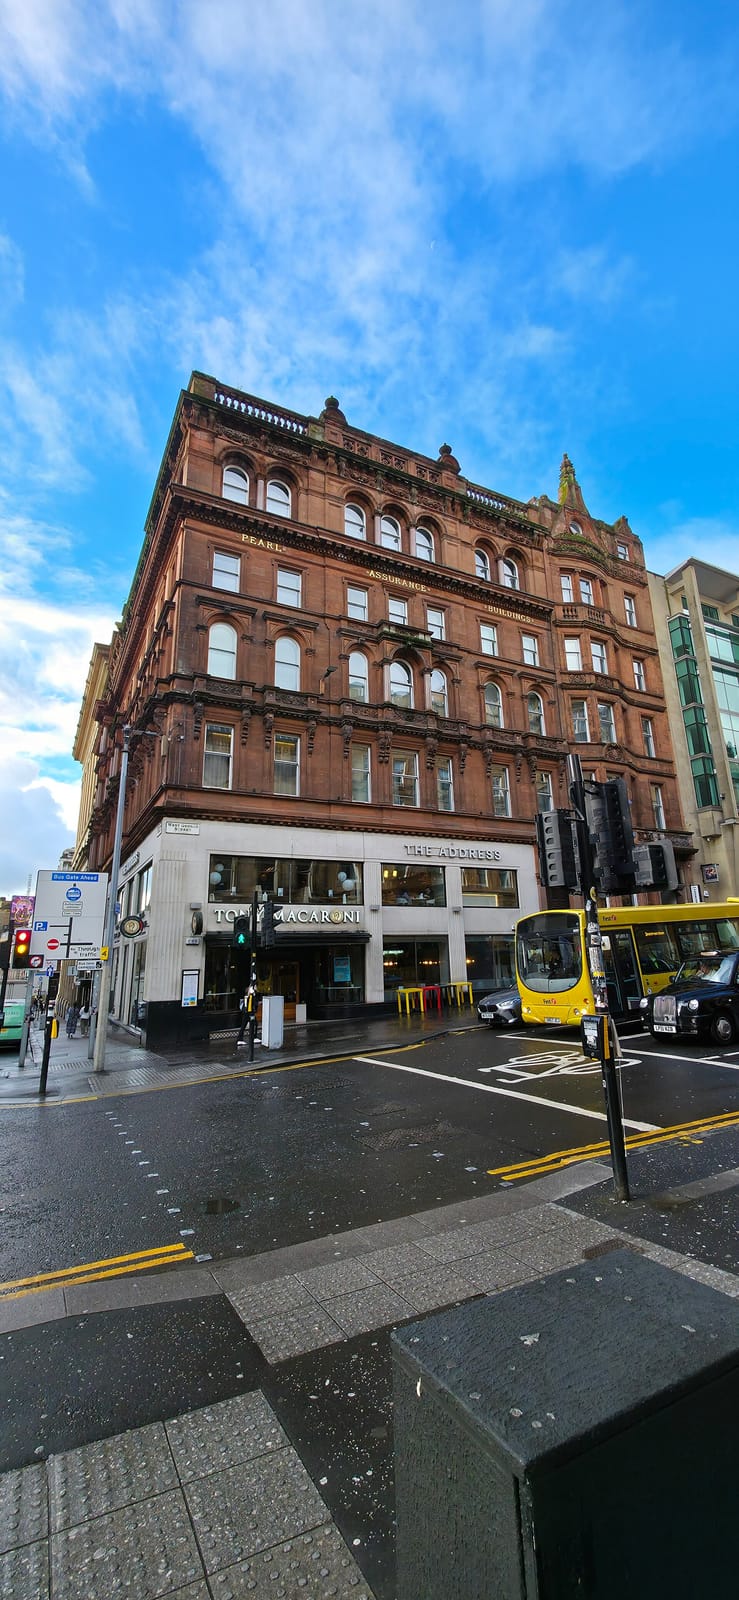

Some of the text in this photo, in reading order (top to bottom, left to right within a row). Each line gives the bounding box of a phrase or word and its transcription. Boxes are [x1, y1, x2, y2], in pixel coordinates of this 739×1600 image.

[241, 533, 531, 623] PEARL ASSURANCE BUILDINGS
[404, 844, 502, 861] THE ADDRESS
